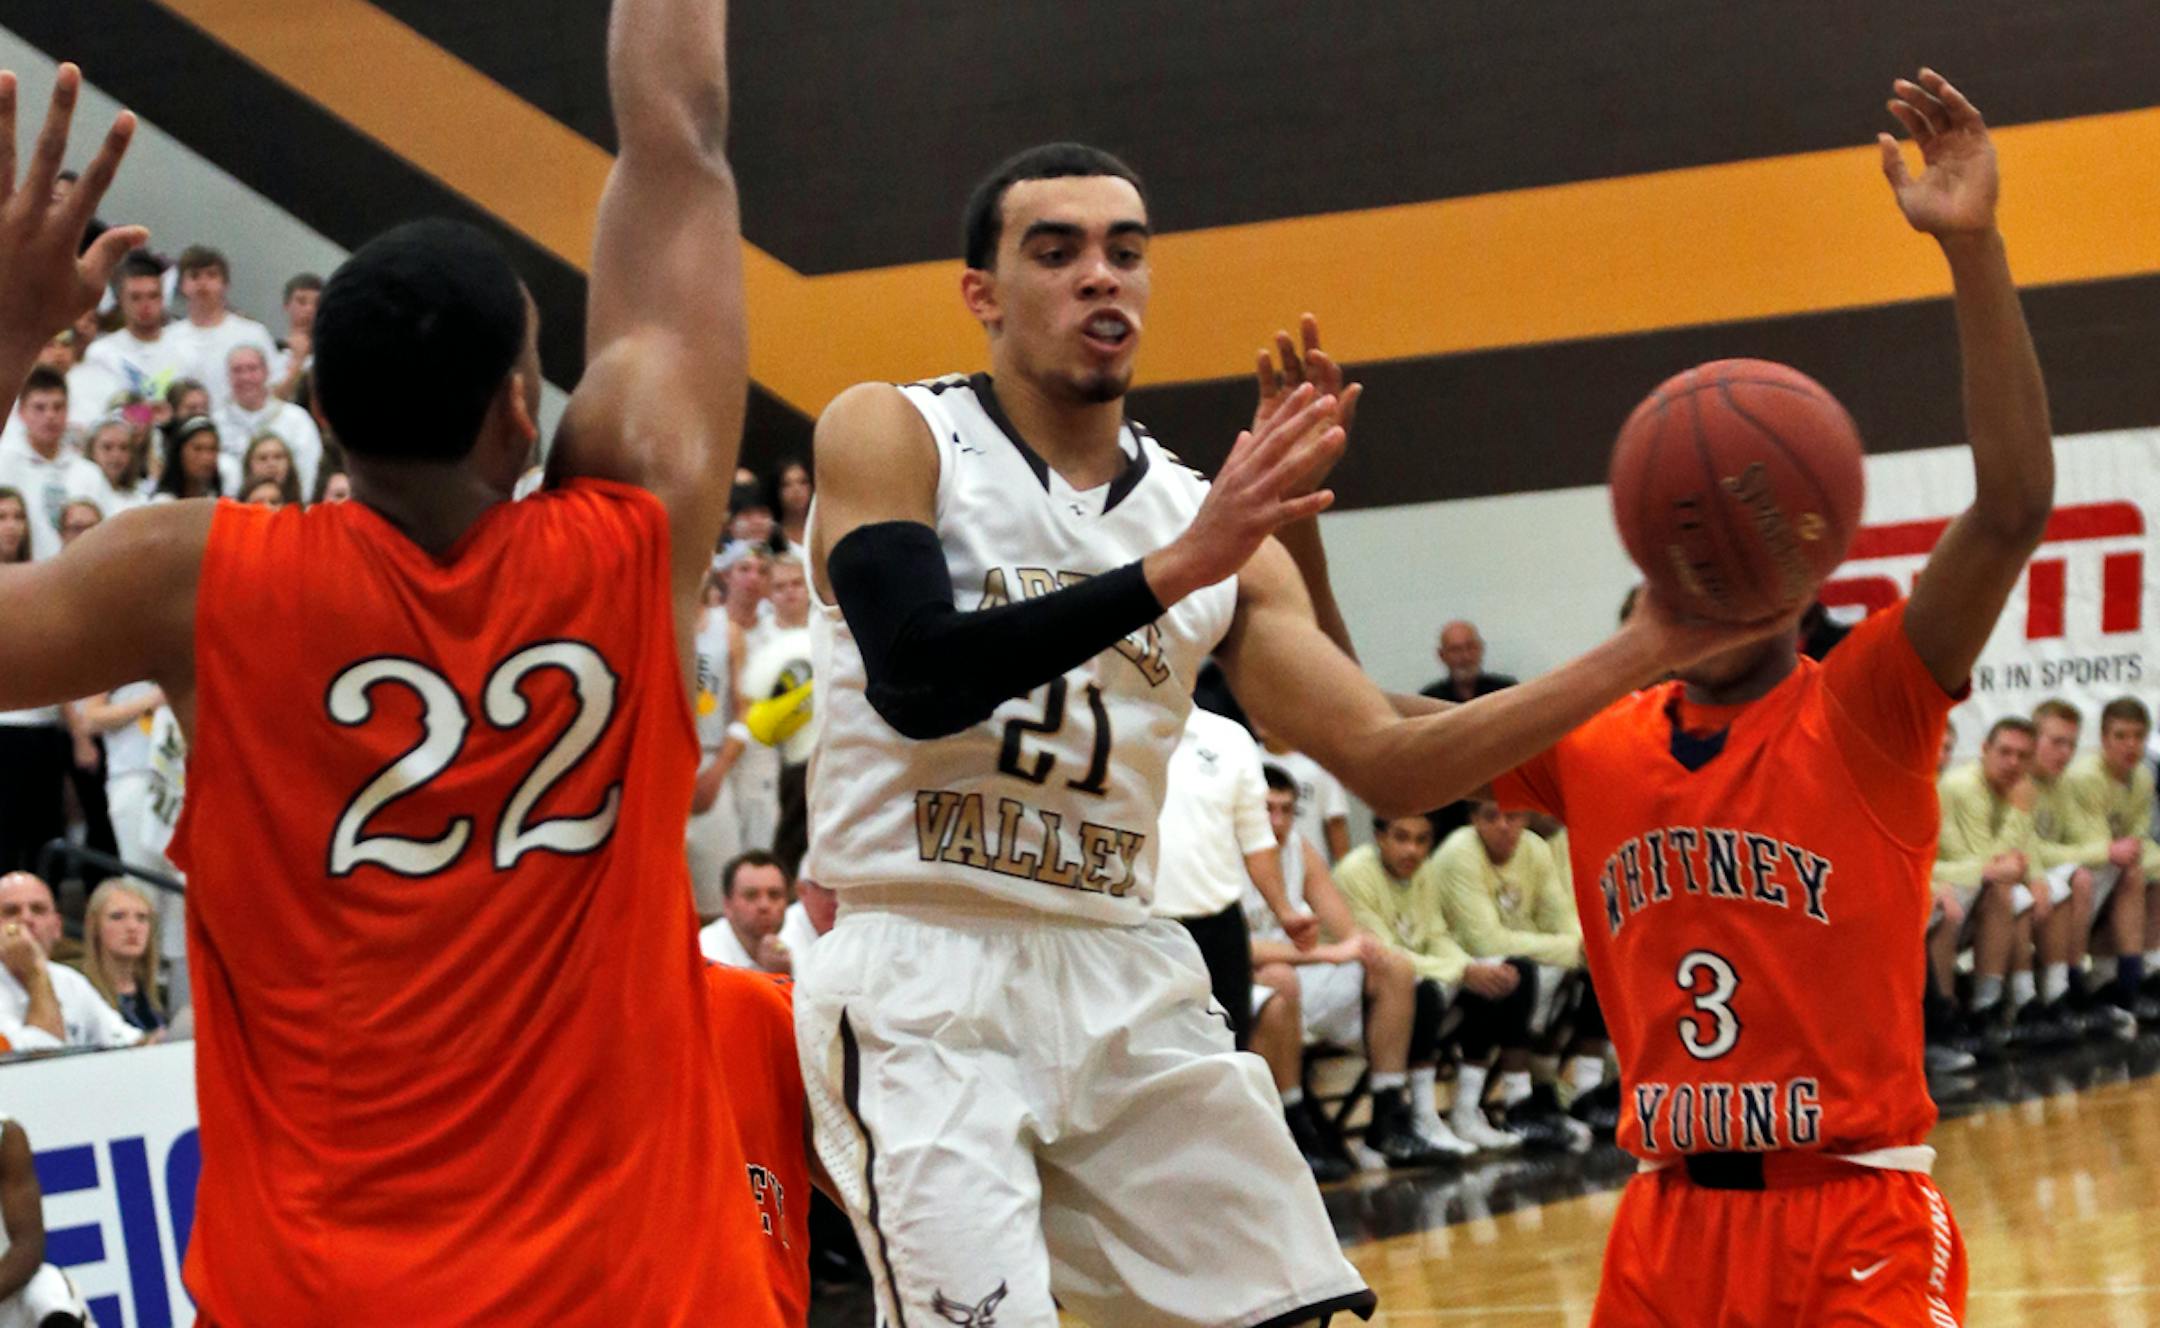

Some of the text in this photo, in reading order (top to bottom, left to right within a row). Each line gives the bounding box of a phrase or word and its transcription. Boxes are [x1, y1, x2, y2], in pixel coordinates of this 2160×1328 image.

[2006, 662, 2031, 689] IN
[2041, 653, 2143, 688] SPORTS
[324, 637, 624, 878] 22
[997, 672, 1112, 797] 21
[914, 789, 1146, 898] VALLEY
[1600, 825, 1832, 938] WHITNEY
[1675, 949, 1742, 1061] 3
[1634, 1076, 1823, 1153] YOUNG
